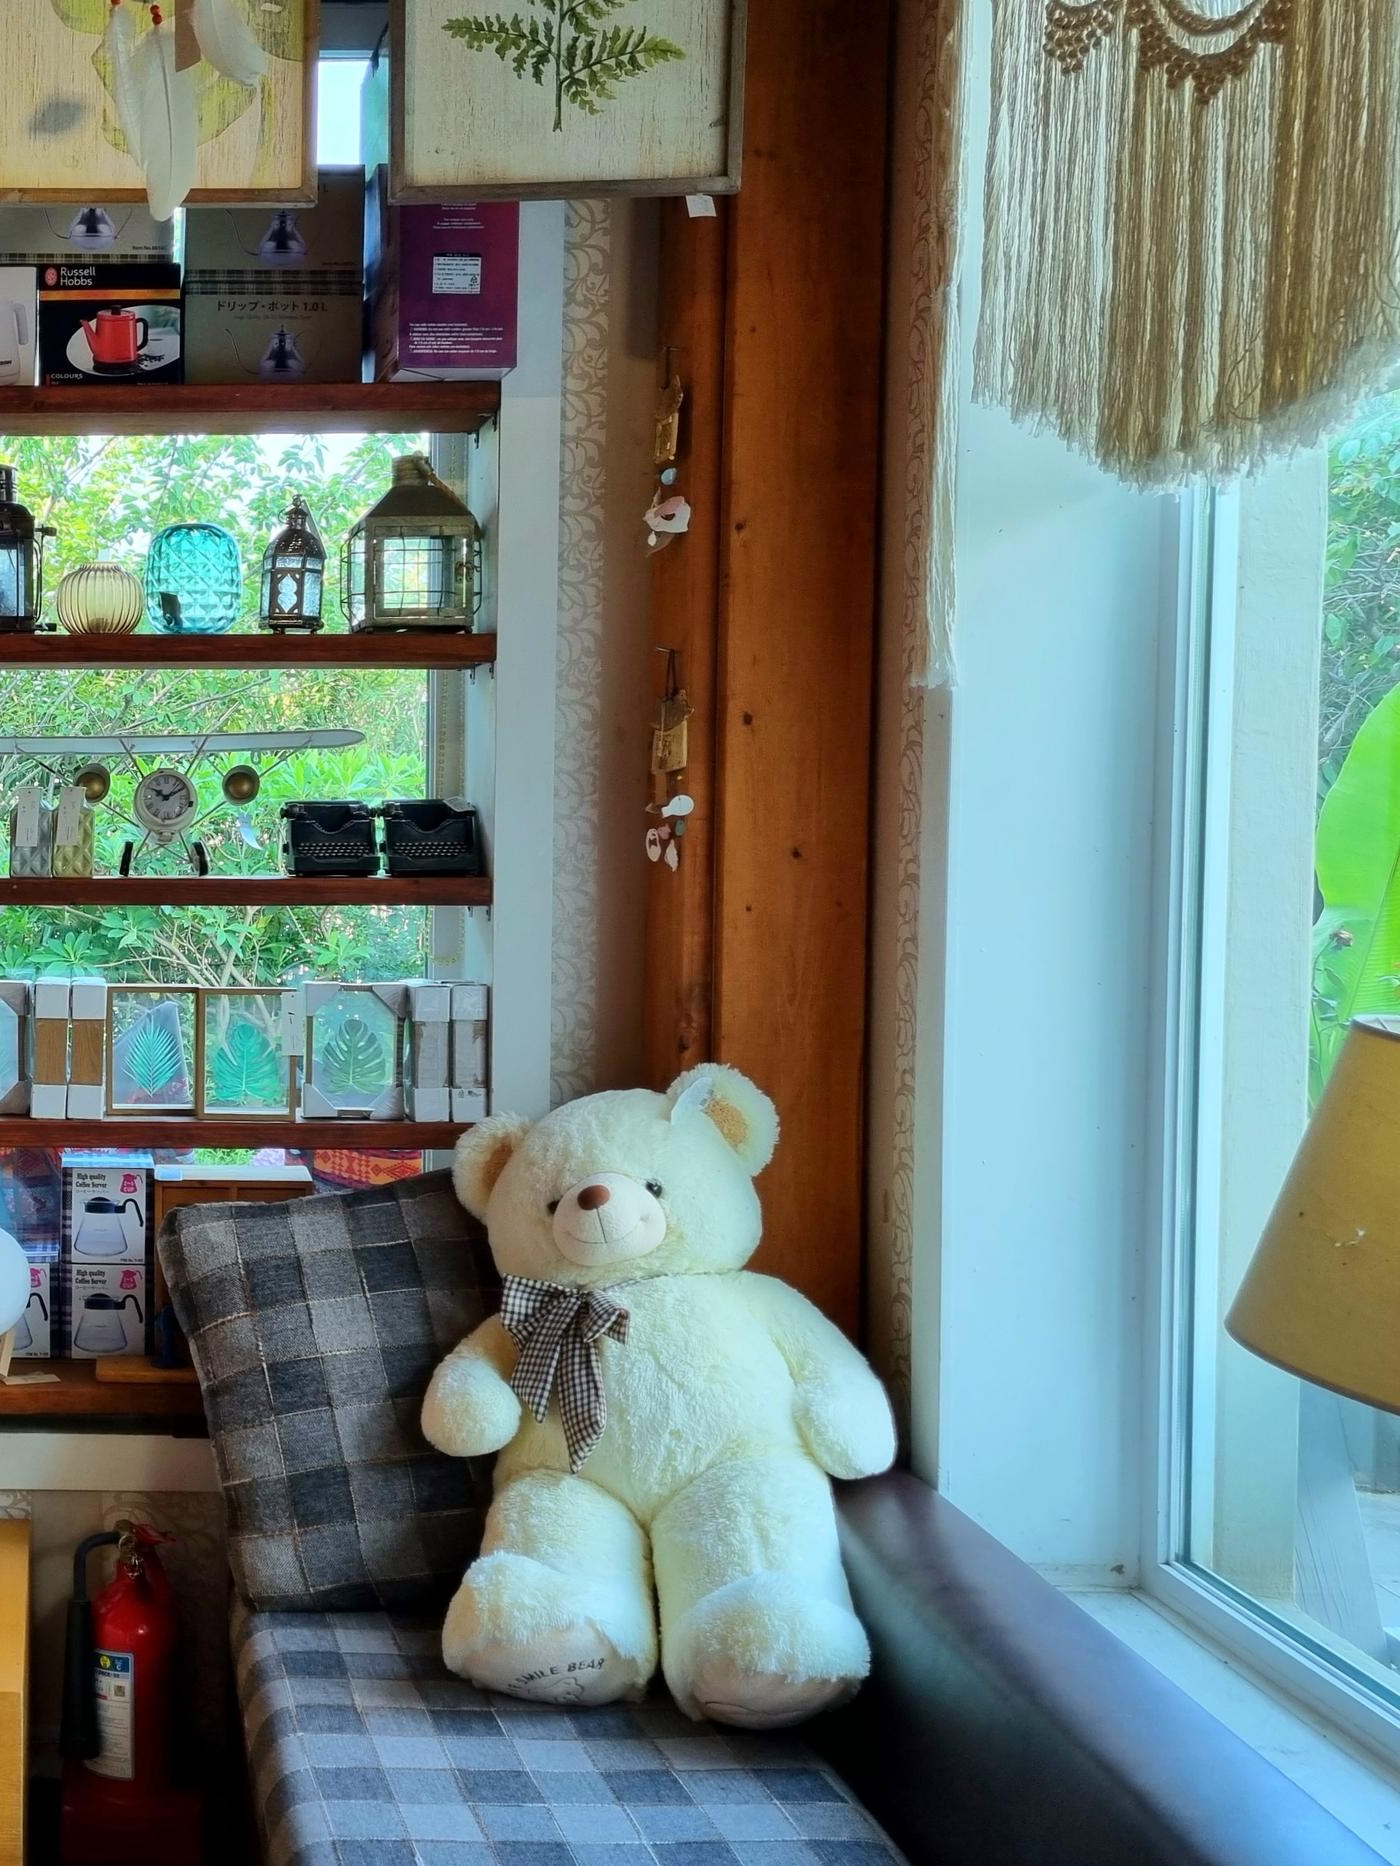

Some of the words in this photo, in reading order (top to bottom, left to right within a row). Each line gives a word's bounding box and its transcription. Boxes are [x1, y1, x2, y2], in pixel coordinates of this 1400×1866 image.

[60, 266, 97, 277] Russell
[60, 277, 93, 287] Hobbs
[76, 1173, 88, 1182] High
[89, 1173, 107, 1182] quality
[76, 1269, 88, 1279] High
[88, 1270, 106, 1280] quality
[91, 1277, 107, 1285] Server
